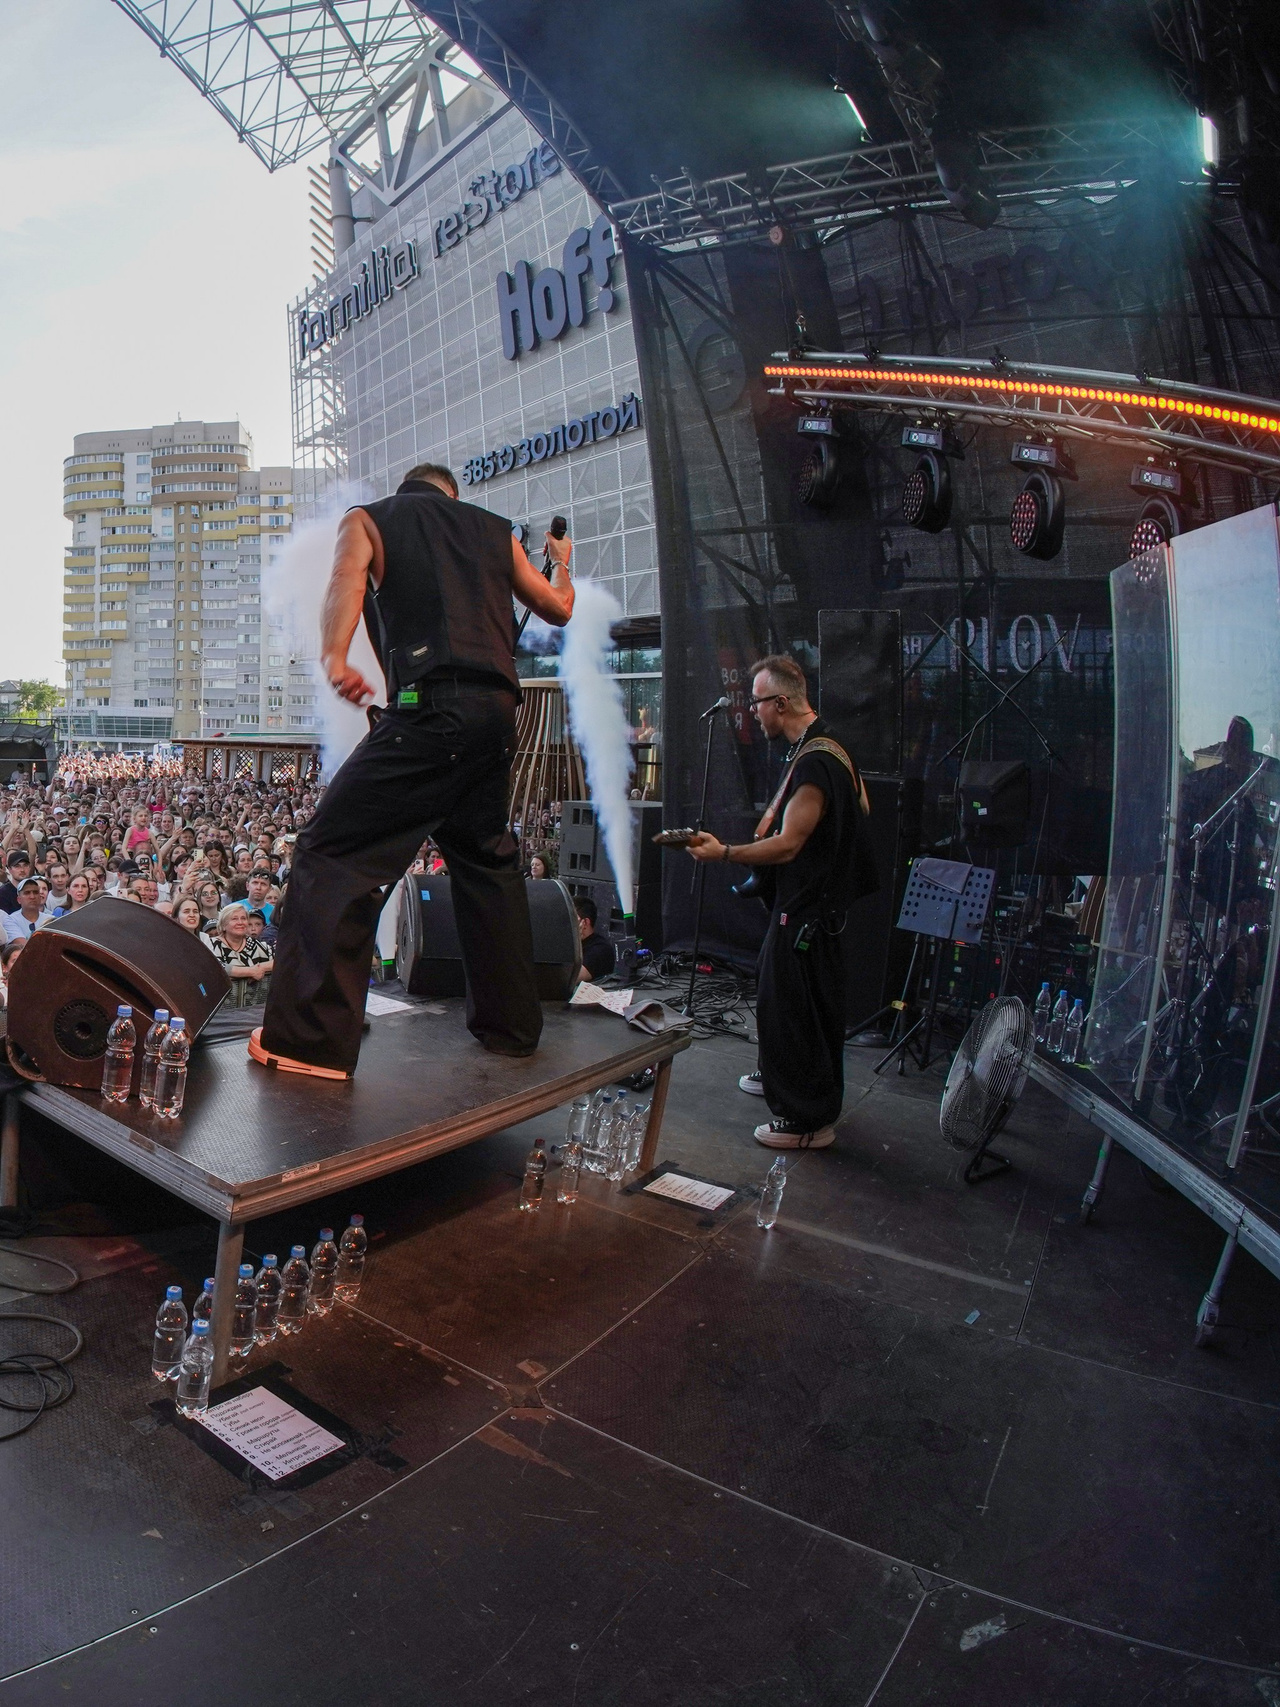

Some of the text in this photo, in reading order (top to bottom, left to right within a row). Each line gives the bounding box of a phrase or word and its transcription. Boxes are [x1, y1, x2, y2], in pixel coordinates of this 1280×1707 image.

[298, 237, 421, 360] familia
[461, 455, 496, 486] 585
[247, 1428, 279, 1445] Маршруты
[253, 1437, 277, 1450] Стирай
